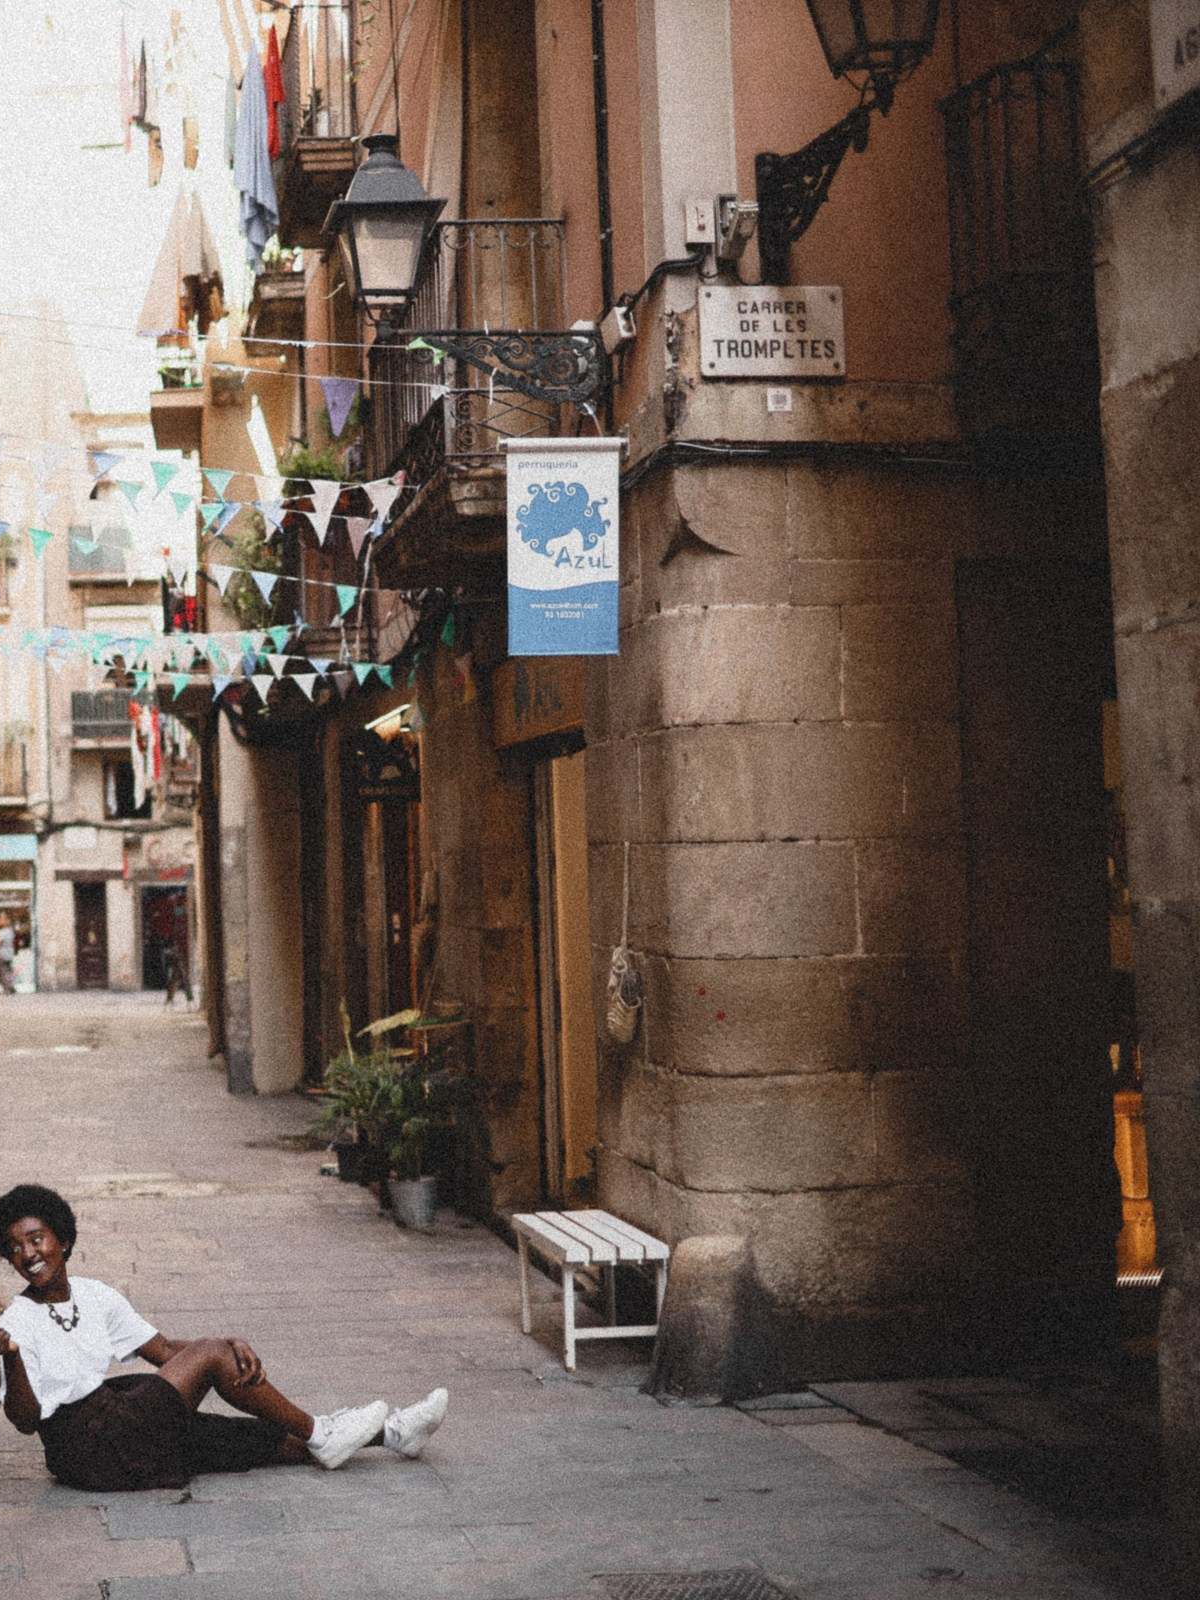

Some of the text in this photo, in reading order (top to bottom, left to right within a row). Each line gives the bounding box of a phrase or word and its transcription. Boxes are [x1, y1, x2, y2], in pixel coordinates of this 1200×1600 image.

[737, 301, 807, 315] CARRER
[773, 319, 807, 333] LES
[518, 460, 578, 470] perruqueria
